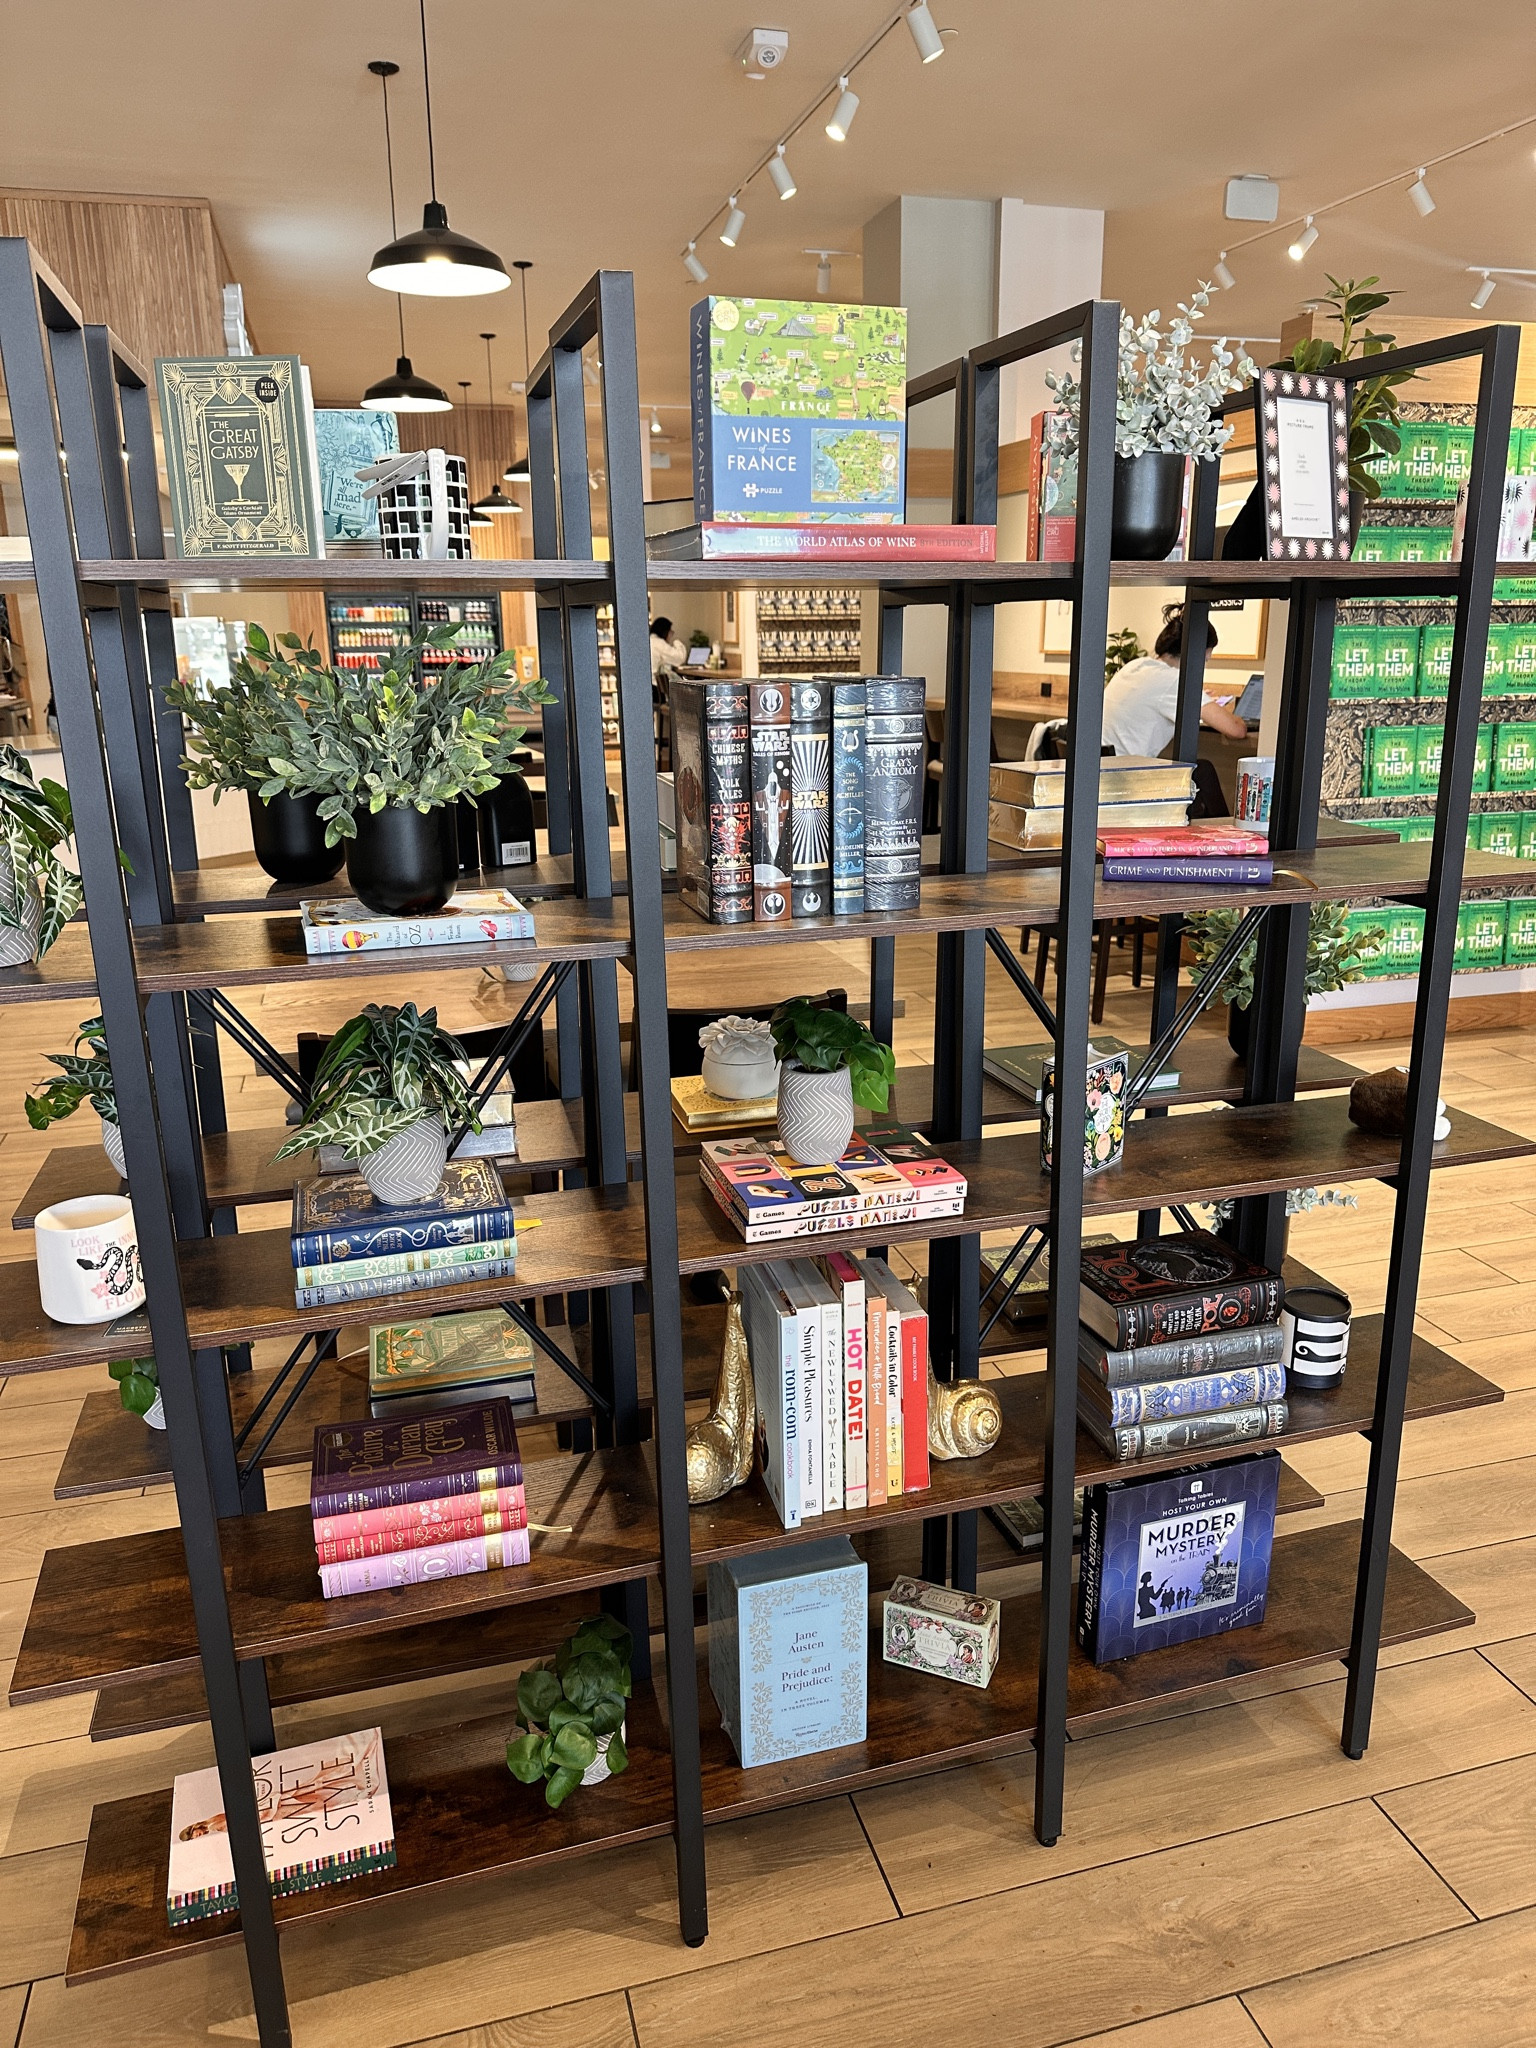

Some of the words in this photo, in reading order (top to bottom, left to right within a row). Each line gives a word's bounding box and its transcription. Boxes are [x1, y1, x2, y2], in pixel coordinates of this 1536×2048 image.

[696, 314, 704, 402] WINES
[260, 381, 276, 389] PEEK
[259, 389, 278, 398] INSIDE
[781, 400, 831, 413] FRANCE
[209, 421, 229, 430] THE
[209, 429, 258, 445] GREAT
[732, 426, 792, 444] WINES
[210, 446, 260, 461] GATSBY
[758, 443, 768, 455] of
[1413, 446, 1438, 461] LET
[727, 455, 797, 472] FRANCE
[1445, 450, 1468, 464] LET
[697, 419, 708, 515] FRANCE
[1404, 461, 1444, 477] THEM
[760, 486, 783, 495] PUZZLE
[337, 493, 362, 504] mad
[757, 535, 783, 547] THE
[784, 536, 827, 548] WORLD
[830, 536, 865, 548] ATLAS
[868, 537, 883, 548] OF
[888, 537, 917, 548] WINE
[936, 538, 973, 548] EDITION
[1358, 550, 1382, 562] LET
[1400, 550, 1424, 562] LET
[1345, 649, 1369, 663] LET
[1385, 649, 1408, 662] LET
[1514, 645, 1536, 659] LET
[1337, 663, 1374, 677] THEM
[1377, 663, 1414, 677] THEM
[1425, 662, 1451, 676] THE
[756, 731, 790, 742] STAR
[712, 743, 746, 753] CHINESE
[752, 741, 790, 751] WARS
[1507, 744, 1529, 757] LET
[715, 756, 743, 766] MYTHS
[1384, 748, 1408, 761] LET
[872, 765, 919, 776] ANATOMY
[1376, 762, 1413, 775] THEM
[1499, 757, 1534, 771] THEM
[720, 778, 740, 788] FOLK
[718, 789, 743, 800] TALES
[793, 791, 828, 800] STAR
[793, 799, 828, 809] WARS
[1490, 833, 1512, 846] LET
[1109, 865, 1143, 876] CRIME
[1163, 867, 1234, 877] PUNISHMENT
[409, 924, 422, 946] OZ
[1393, 928, 1418, 940] LET
[1475, 922, 1498, 935] LET
[1387, 940, 1424, 954] THEM
[1467, 935, 1503, 948] THEM
[762, 1210, 785, 1218] Games
[797, 1197, 858, 1216] PUZZLE
[759, 1227, 782, 1236] Games
[793, 1214, 855, 1235] PUZZLE
[71, 1235, 100, 1248] LOOK
[381, 1232, 389, 1252] BLUE
[79, 1243, 105, 1256] LIKE
[1185, 1305, 1195, 1331] EDGAR
[1201, 1292, 1223, 1334] POE
[803, 1325, 815, 1367] Simple
[847, 1328, 862, 1371] HOT
[888, 1325, 898, 1362] Cocktails
[872, 1363, 885, 1381] Milk
[889, 1362, 897, 1373] in
[827, 1340, 838, 1416] NEWLYWED
[888, 1373, 898, 1398] Color
[803, 1368, 817, 1423] Pleasures
[871, 1381, 885, 1406] Bread
[785, 1369, 797, 1441] rom-com
[848, 1379, 863, 1441] DATE!
[482, 1410, 493, 1433] WILDE
[424, 1417, 466, 1454] Gray
[392, 1422, 433, 1470] Dorian
[487, 1433, 498, 1456] OSCAR
[348, 1428, 390, 1477] Picture
[786, 1442, 794, 1479] cookbook
[828, 1442, 837, 1488] TABLE
[1162, 1507, 1183, 1517] HOST
[1185, 1501, 1206, 1512] YOUR
[1209, 1496, 1228, 1506] OWN
[1178, 1496, 1197, 1504] Talking
[1148, 1511, 1236, 1547] MURDER
[1087, 1508, 1099, 1567] MURDER
[1155, 1531, 1226, 1559] MYSTERY
[1083, 1568, 1095, 1630] MYSTERY
[1230, 1593, 1264, 1618] criminally
[1228, 1611, 1243, 1628] good
[795, 1630, 818, 1644] Jane
[919, 1636, 951, 1651] TRIVIA
[788, 1641, 825, 1655] Austen
[782, 1668, 810, 1682] Pride
[811, 1662, 831, 1675] and
[782, 1675, 834, 1693] Prejudice:
[364, 1756, 372, 1789] CHAPELLE
[321, 1752, 360, 1831] STYLE
[279, 1764, 319, 1844] SWIFT
[367, 1795, 375, 1814] SARAH
[290, 1872, 323, 1889] STYLE
[200, 1895, 239, 1913] TAYLO
